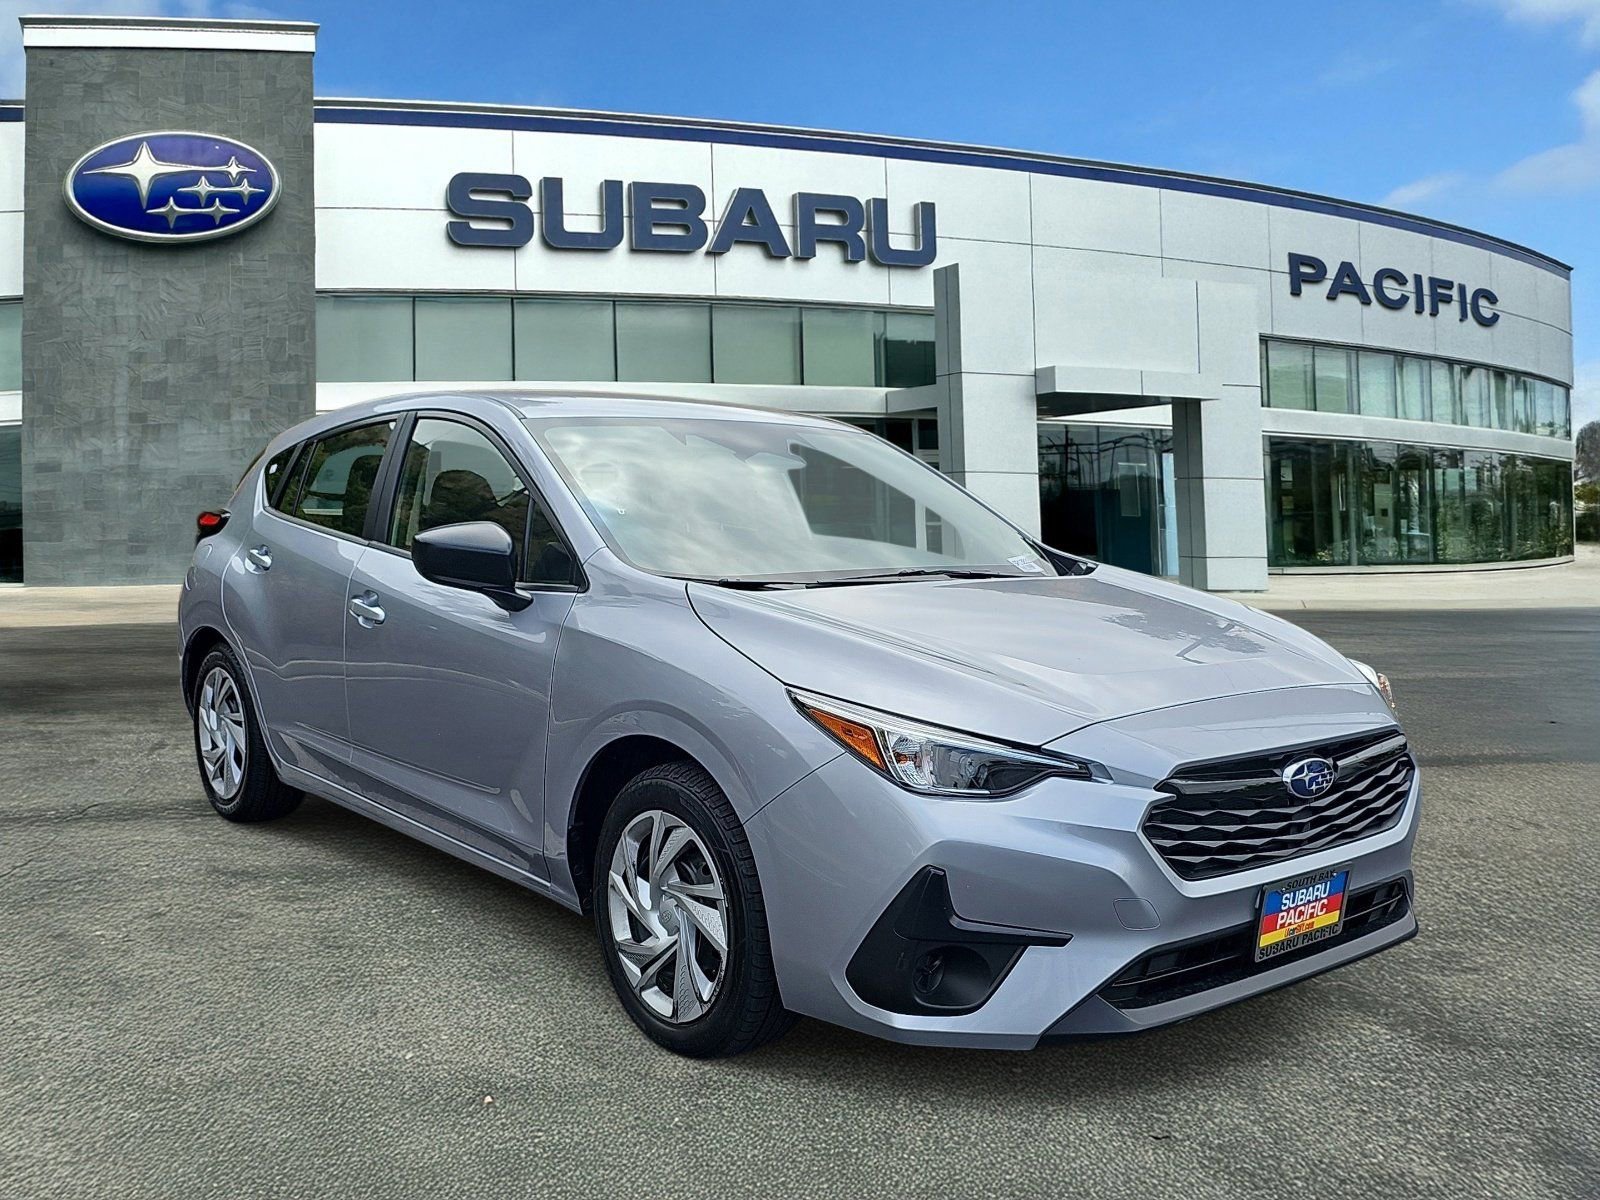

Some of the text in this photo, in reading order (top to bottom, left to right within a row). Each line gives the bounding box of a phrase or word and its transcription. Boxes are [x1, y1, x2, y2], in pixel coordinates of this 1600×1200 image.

[446, 172, 937, 267] SUBARU
[1288, 252, 1501, 327] PACIFIC
[1281, 881, 1330, 910] SUBARU
[1286, 874, 1317, 890] SOUTH
[1276, 899, 1328, 929] PACIFIC
[1258, 924, 1340, 960] SUBARU PACIFIC
